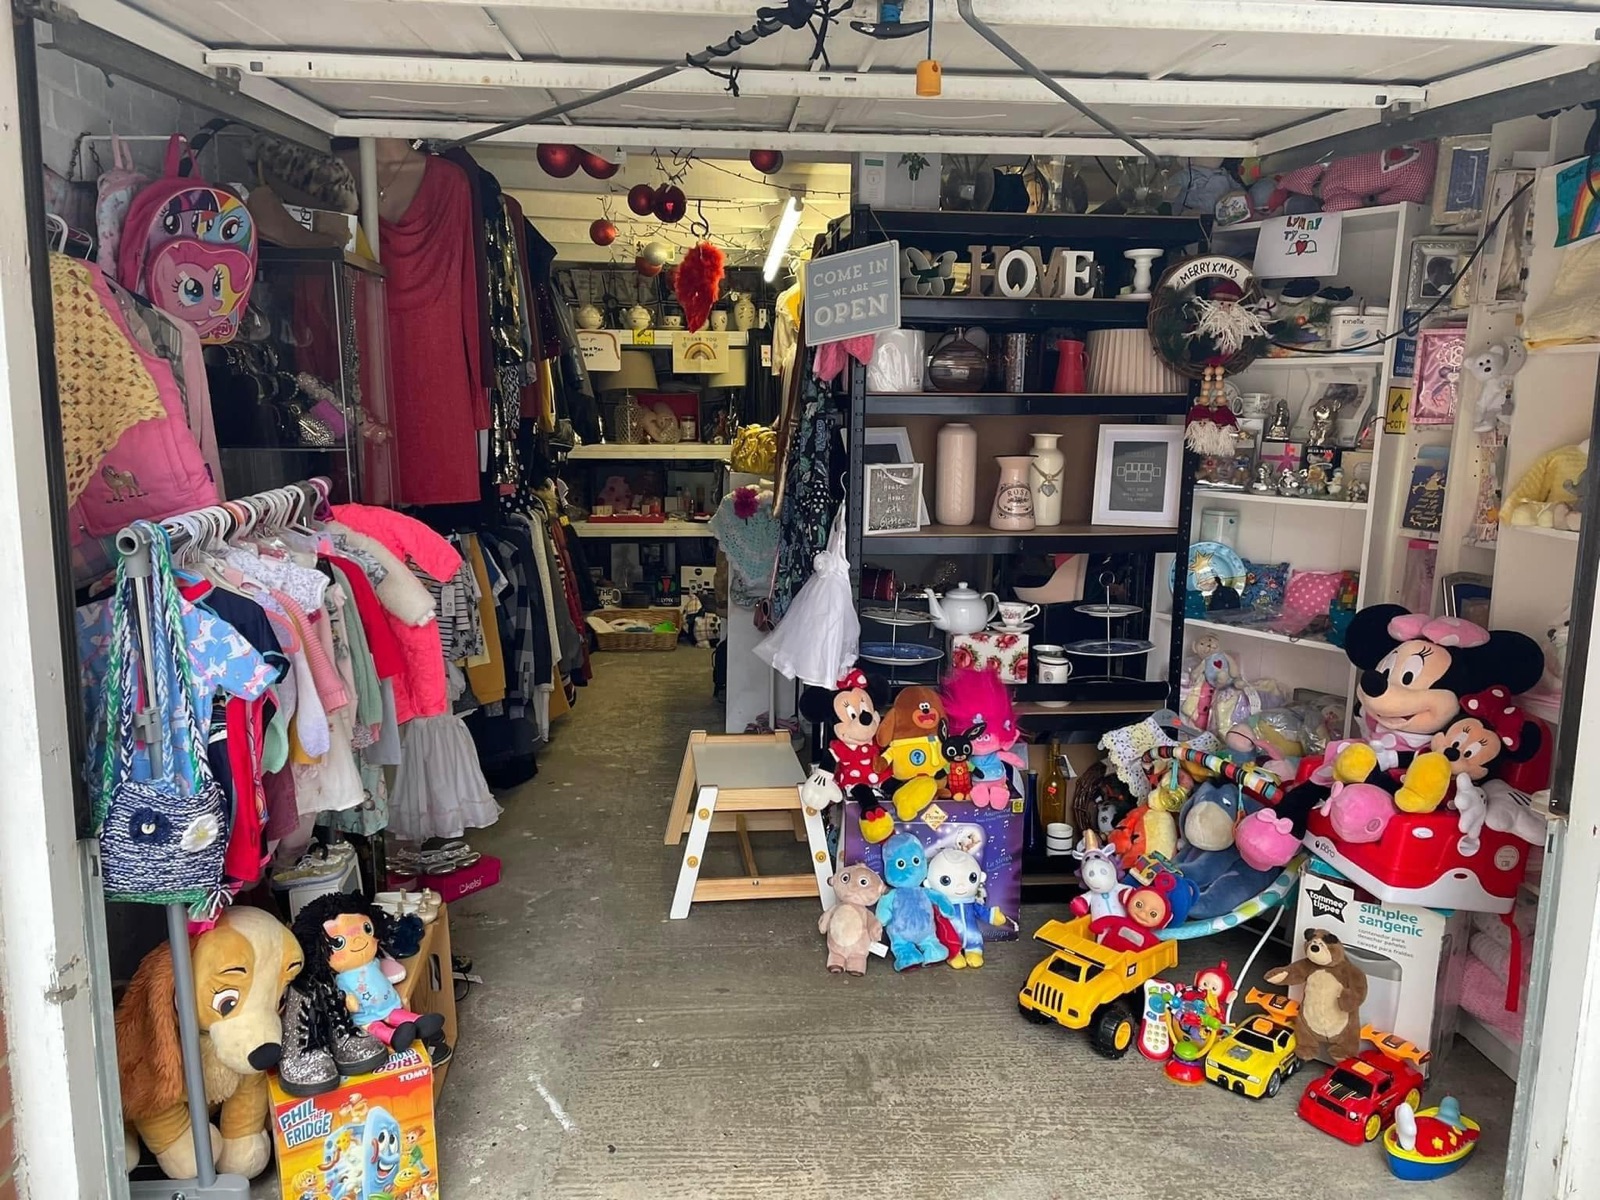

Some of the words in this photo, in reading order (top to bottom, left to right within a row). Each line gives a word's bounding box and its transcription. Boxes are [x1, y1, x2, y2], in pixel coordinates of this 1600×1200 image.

[813, 264, 862, 287] COME
[868, 258, 888, 275] IN
[968, 245, 1094, 298] HOME
[1180, 262, 1210, 285] MERRY
[1212, 262, 1240, 279] XMAS
[832, 287, 847, 297] WE
[850, 282, 869, 293] ARE
[814, 293, 889, 326] OPEN
[1390, 420, 1406, 429] CCTV
[1309, 891, 1344, 908] tommee
[1313, 900, 1340, 915] tippee
[1360, 904, 1418, 924] simplee
[1358, 915, 1423, 937] sangenic
[373, 1055, 423, 1074] FRIGO
[398, 1067, 430, 1083] TOMY
[280, 1099, 316, 1130] PHIL
[309, 1110, 324, 1122] THE
[285, 1113, 333, 1147] FRIDGE
